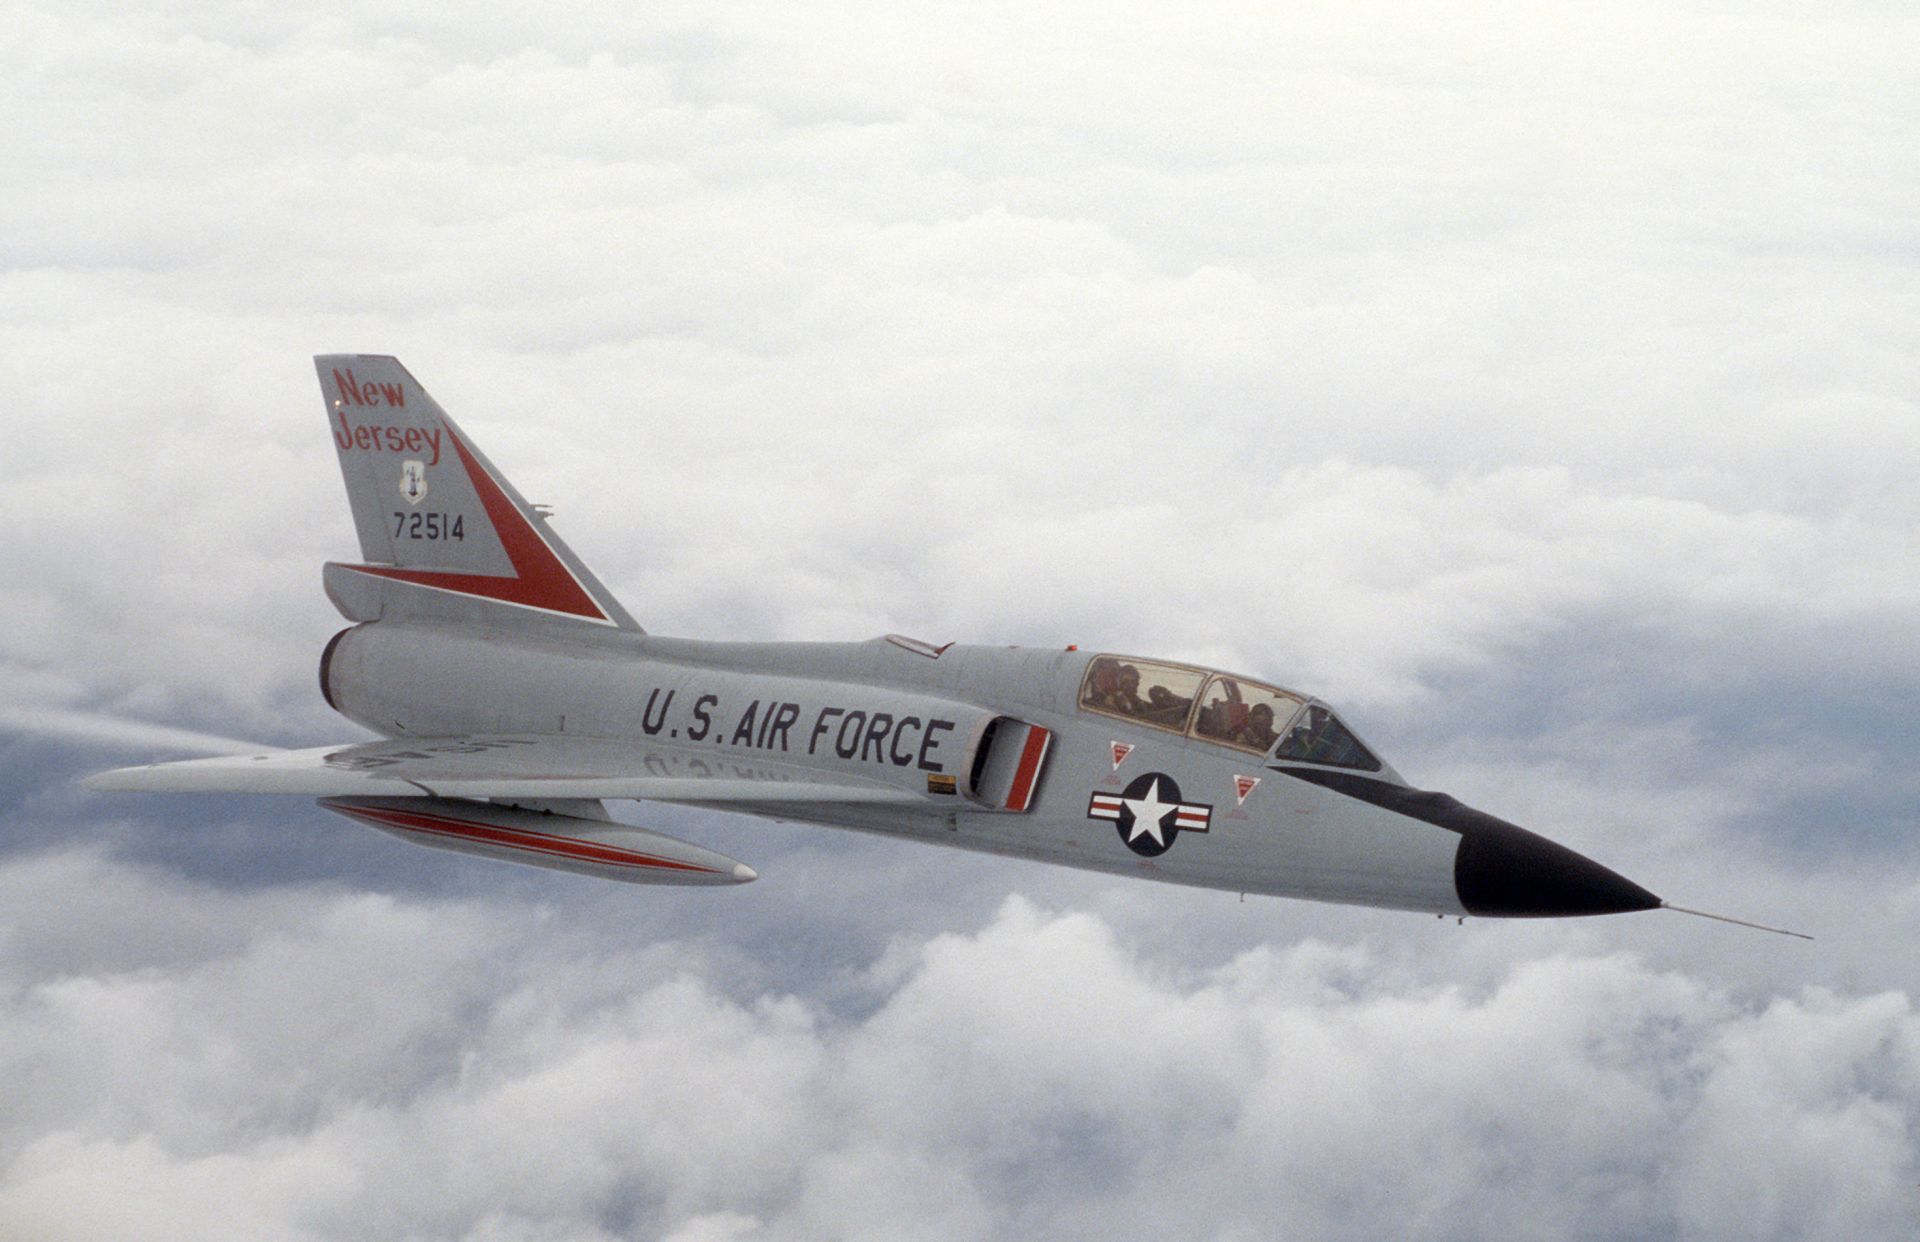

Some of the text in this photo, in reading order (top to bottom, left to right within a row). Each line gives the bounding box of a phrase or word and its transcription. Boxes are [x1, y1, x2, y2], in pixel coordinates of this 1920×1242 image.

[332, 367, 404, 407] New
[335, 411, 441, 466] Jersey
[394, 512, 464, 541] 72514
[642, 688, 723, 744] U.S.
[731, 700, 800, 751] AIR
[808, 707, 956, 772] FORCE
